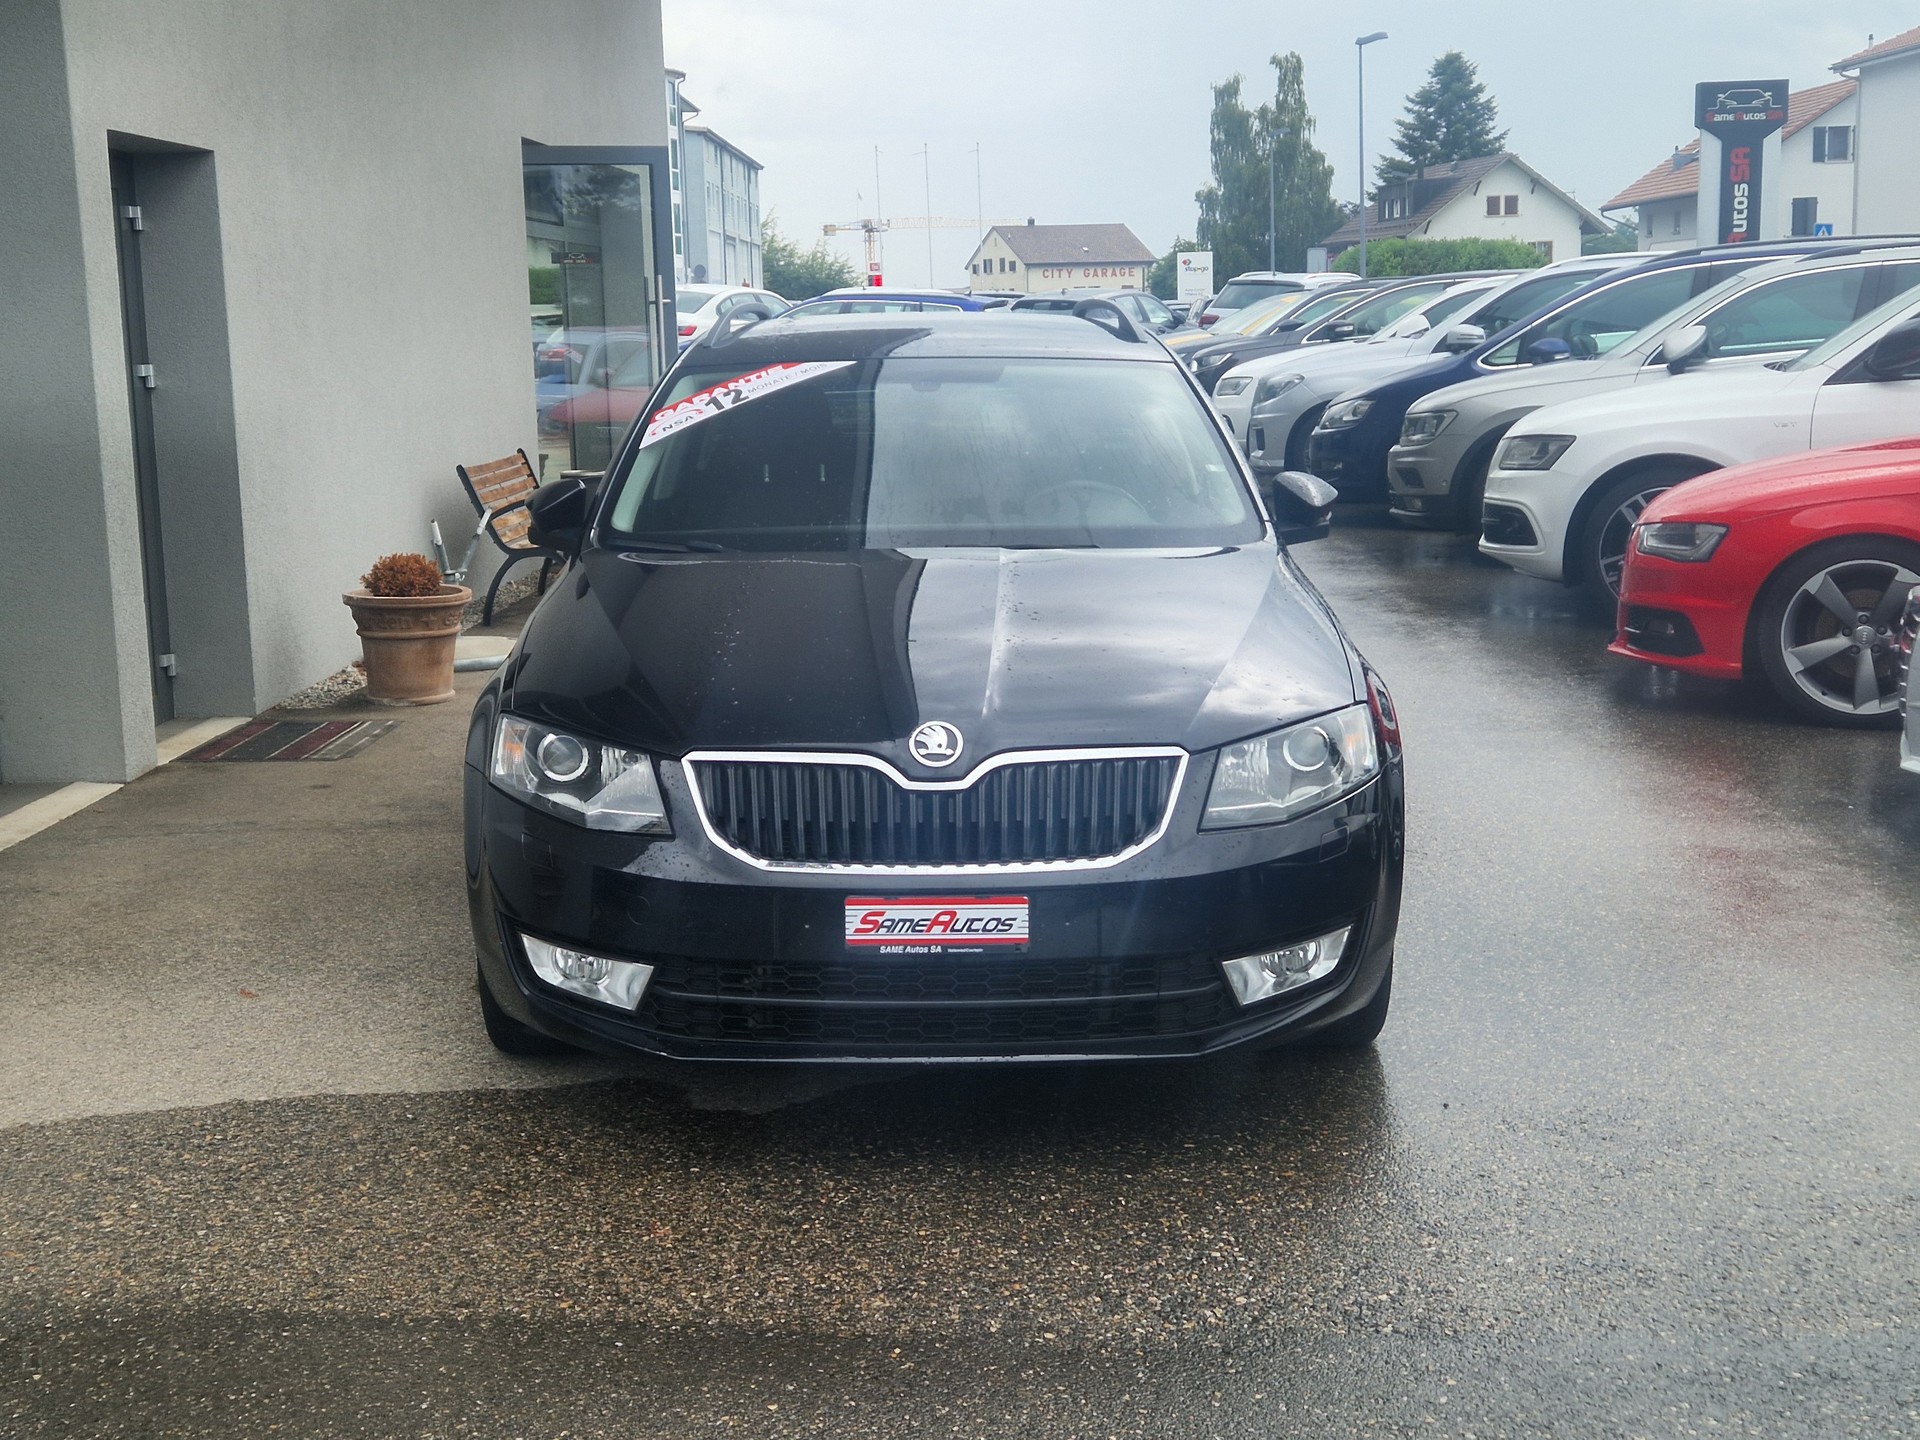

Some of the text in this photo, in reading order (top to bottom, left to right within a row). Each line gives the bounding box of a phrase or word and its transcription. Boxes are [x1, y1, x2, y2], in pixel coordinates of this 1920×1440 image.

[1042, 266, 1135, 279] CITY GARAGE
[654, 364, 787, 422] GARANTIE
[705, 387, 750, 411] 12
[747, 374, 791, 394] MONATE
[800, 363, 828, 375] MOIS
[662, 414, 695, 433] NSA
[879, 945, 905, 954] SAME
[906, 945, 929, 954] Autos
[930, 945, 942, 953] SA
